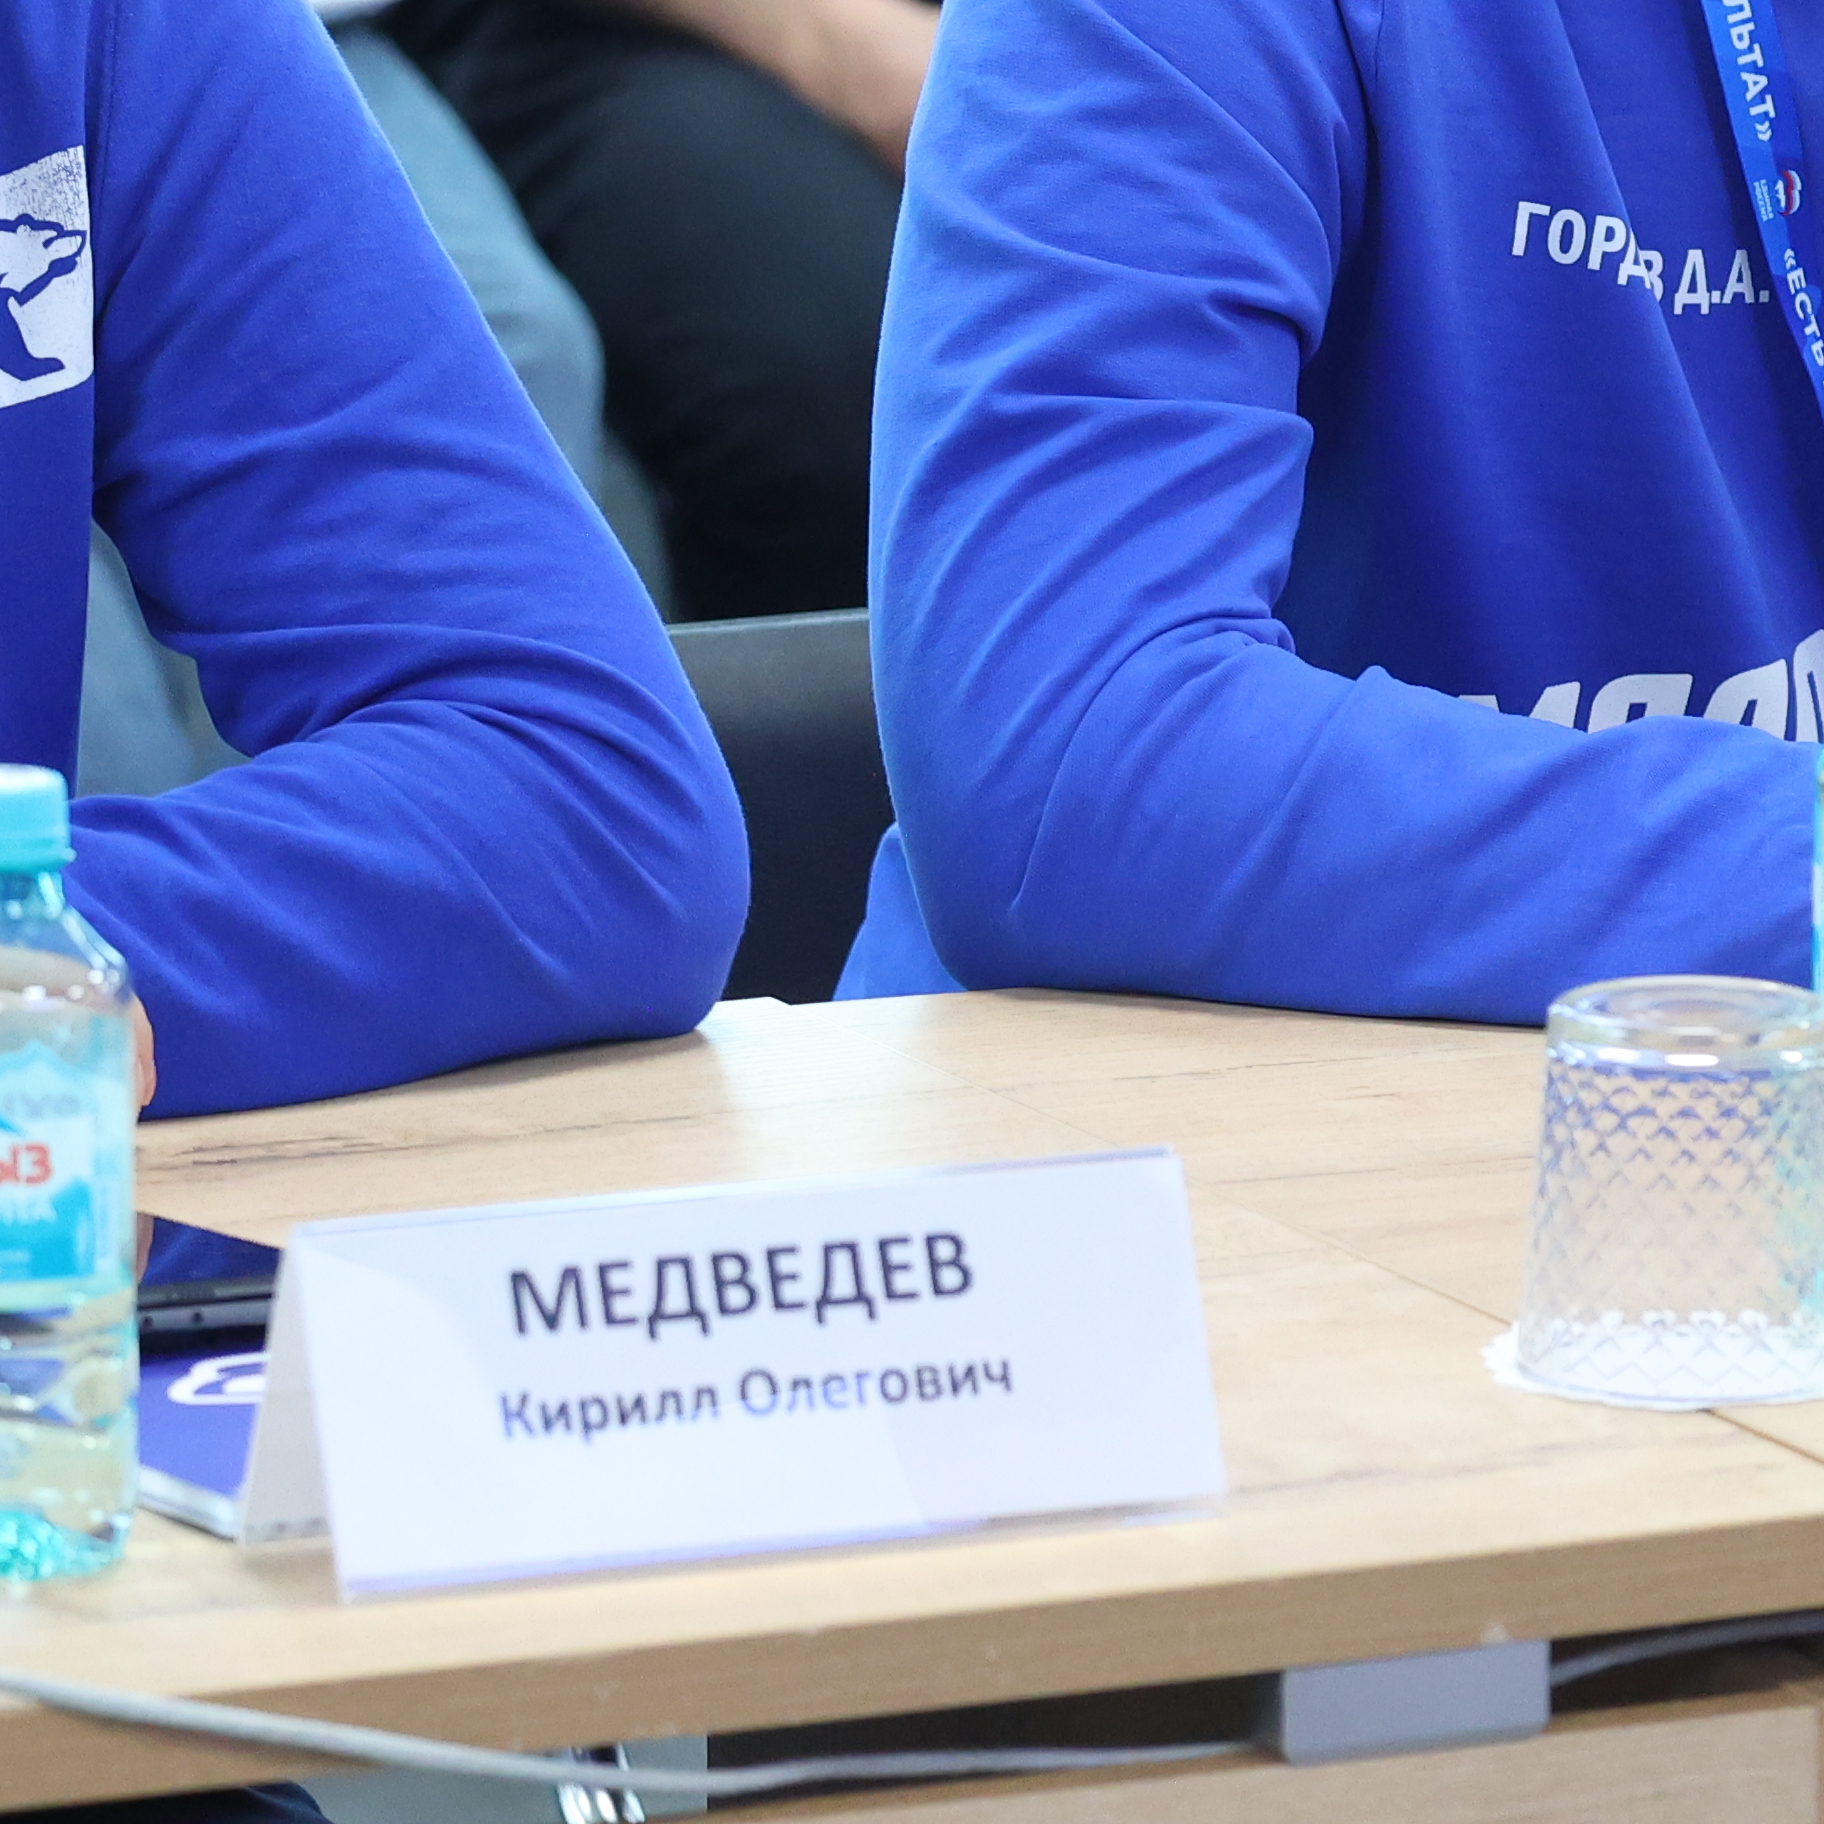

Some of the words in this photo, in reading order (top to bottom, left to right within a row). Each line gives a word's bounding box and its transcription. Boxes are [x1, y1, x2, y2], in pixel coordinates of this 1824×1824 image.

[1673, 248, 1770, 315] Д.А.
[1782, 247, 1824, 367] «ЕСТЬ
[509, 1231, 974, 1341] МЕДВЕДЕВ
[498, 1384, 721, 1446] Кирилл
[738, 1358, 1013, 1417] Олегович
